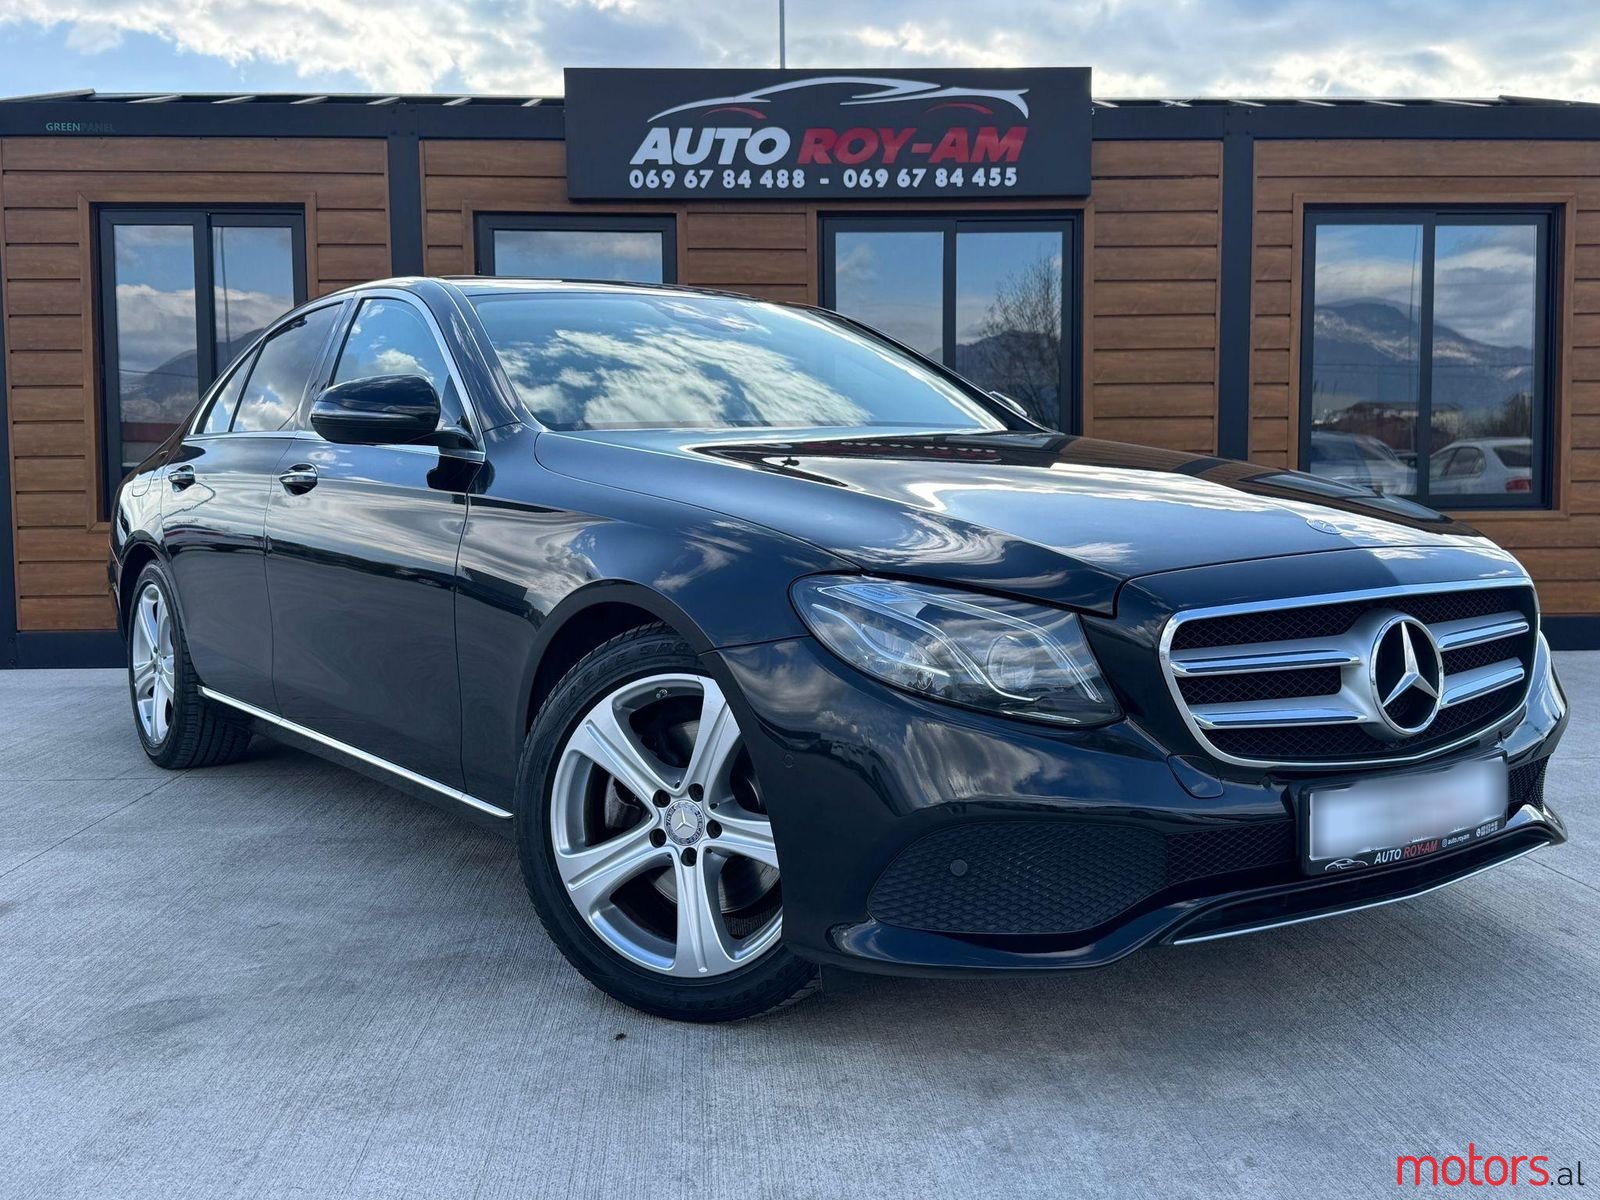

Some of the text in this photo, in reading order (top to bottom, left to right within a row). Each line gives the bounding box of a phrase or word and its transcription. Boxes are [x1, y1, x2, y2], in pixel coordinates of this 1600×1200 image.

[629, 127, 1027, 165] AUTO ROY-AM
[629, 169, 676, 189] 069
[684, 169, 713, 188] 67
[722, 168, 752, 188] 84
[759, 168, 806, 188] 488
[843, 168, 889, 188] 069
[896, 168, 926, 187] 67
[935, 167, 963, 187] 84
[971, 167, 1018, 187] 455
[1374, 849, 1402, 865] AUTO
[1403, 841, 1438, 858] ROY-AM
